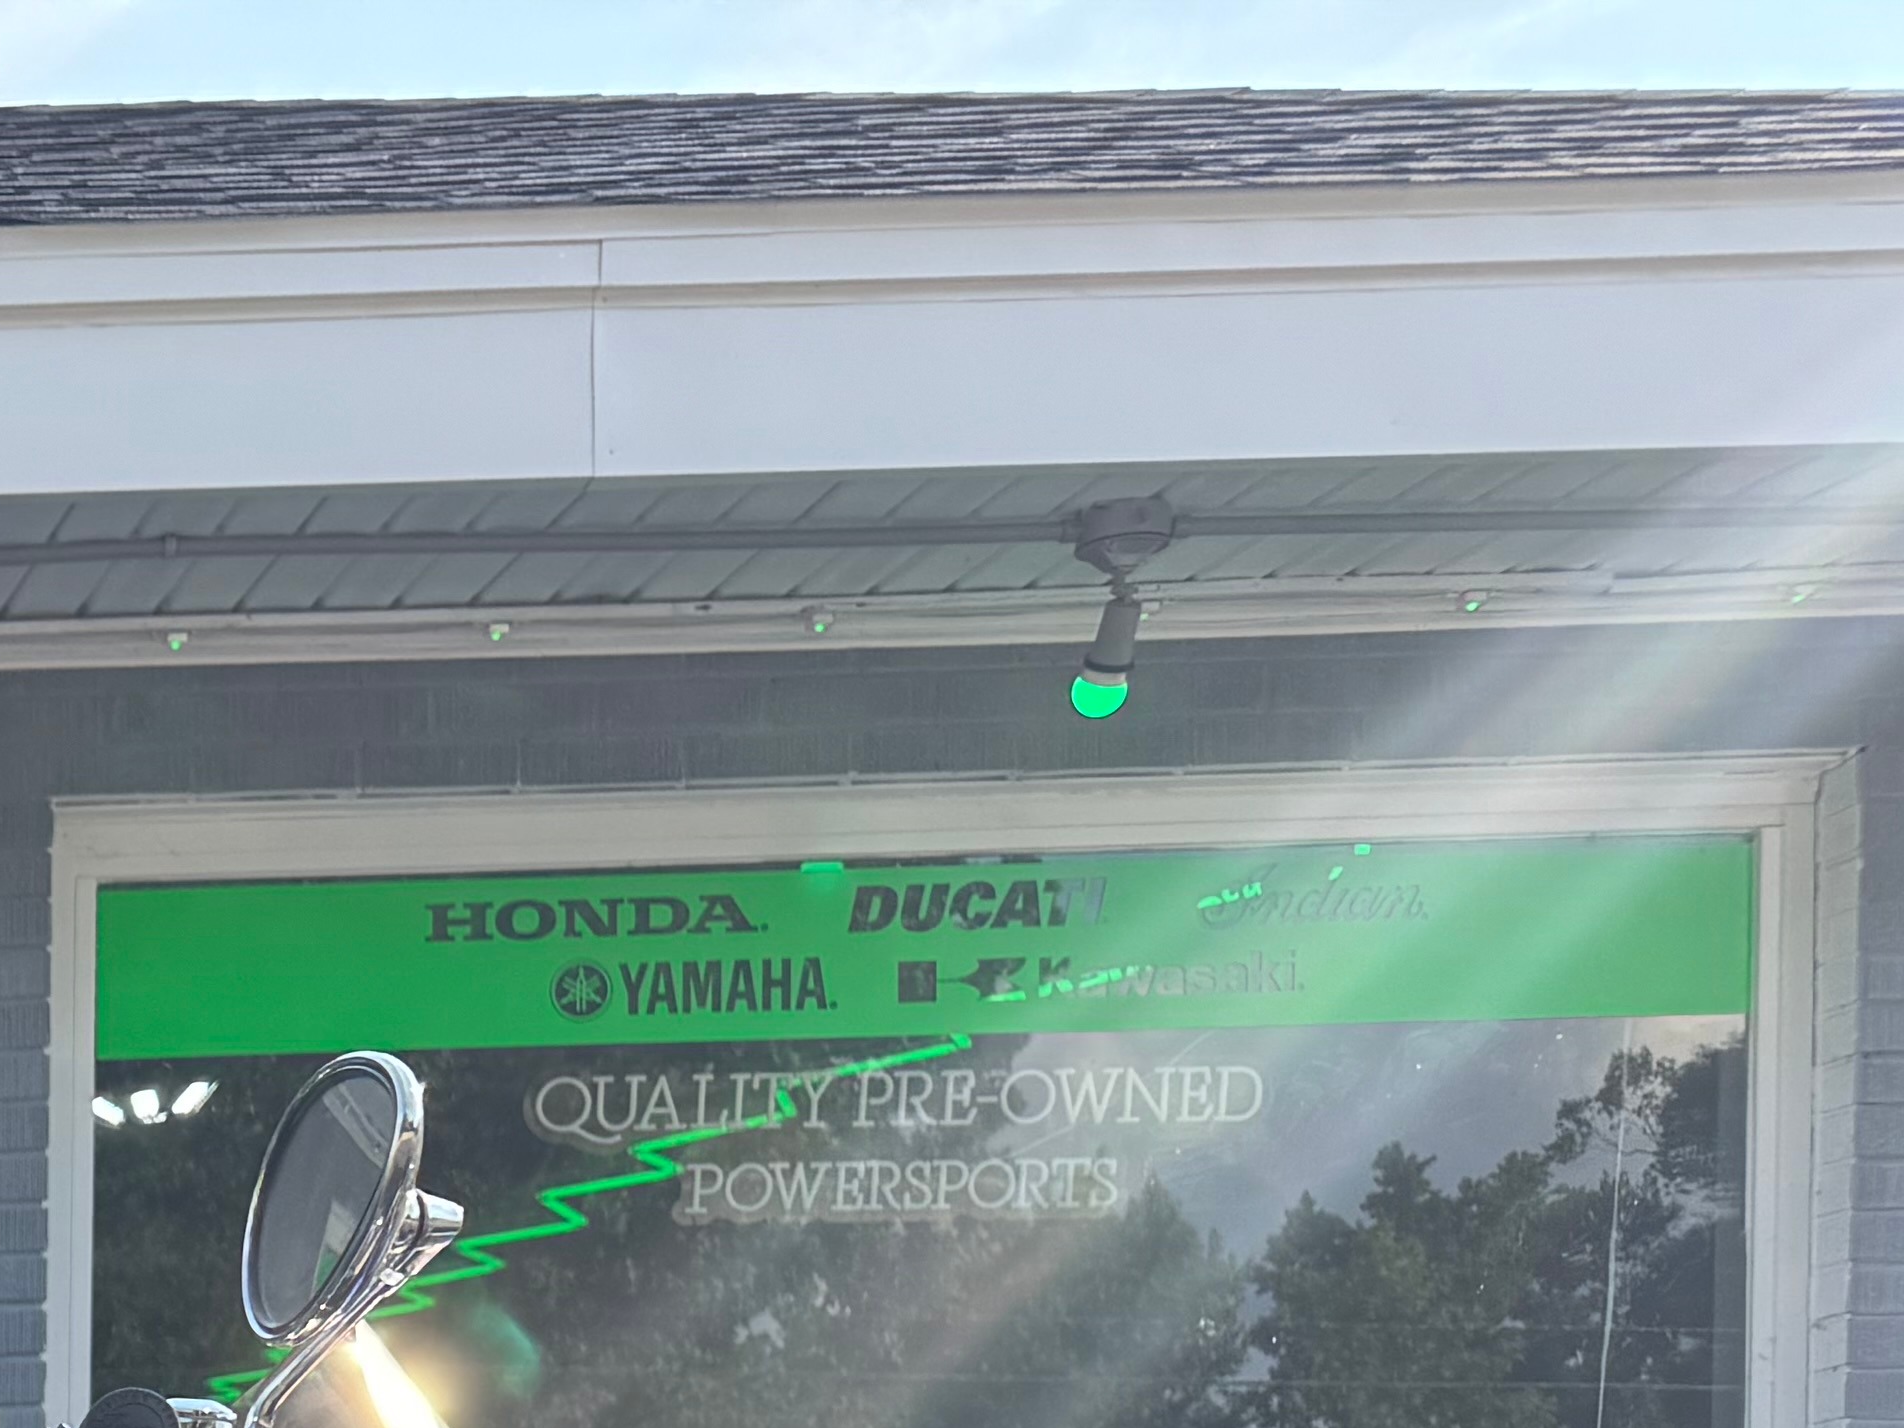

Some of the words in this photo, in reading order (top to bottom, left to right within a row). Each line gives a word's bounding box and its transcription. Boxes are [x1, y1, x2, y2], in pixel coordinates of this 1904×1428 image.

[848, 877, 1108, 934] DUCATI
[536, 1073, 837, 1144] QUALITY
[854, 1065, 1263, 1129] PRE-OWNED
[686, 1157, 1120, 1214] POWERSPORTS
